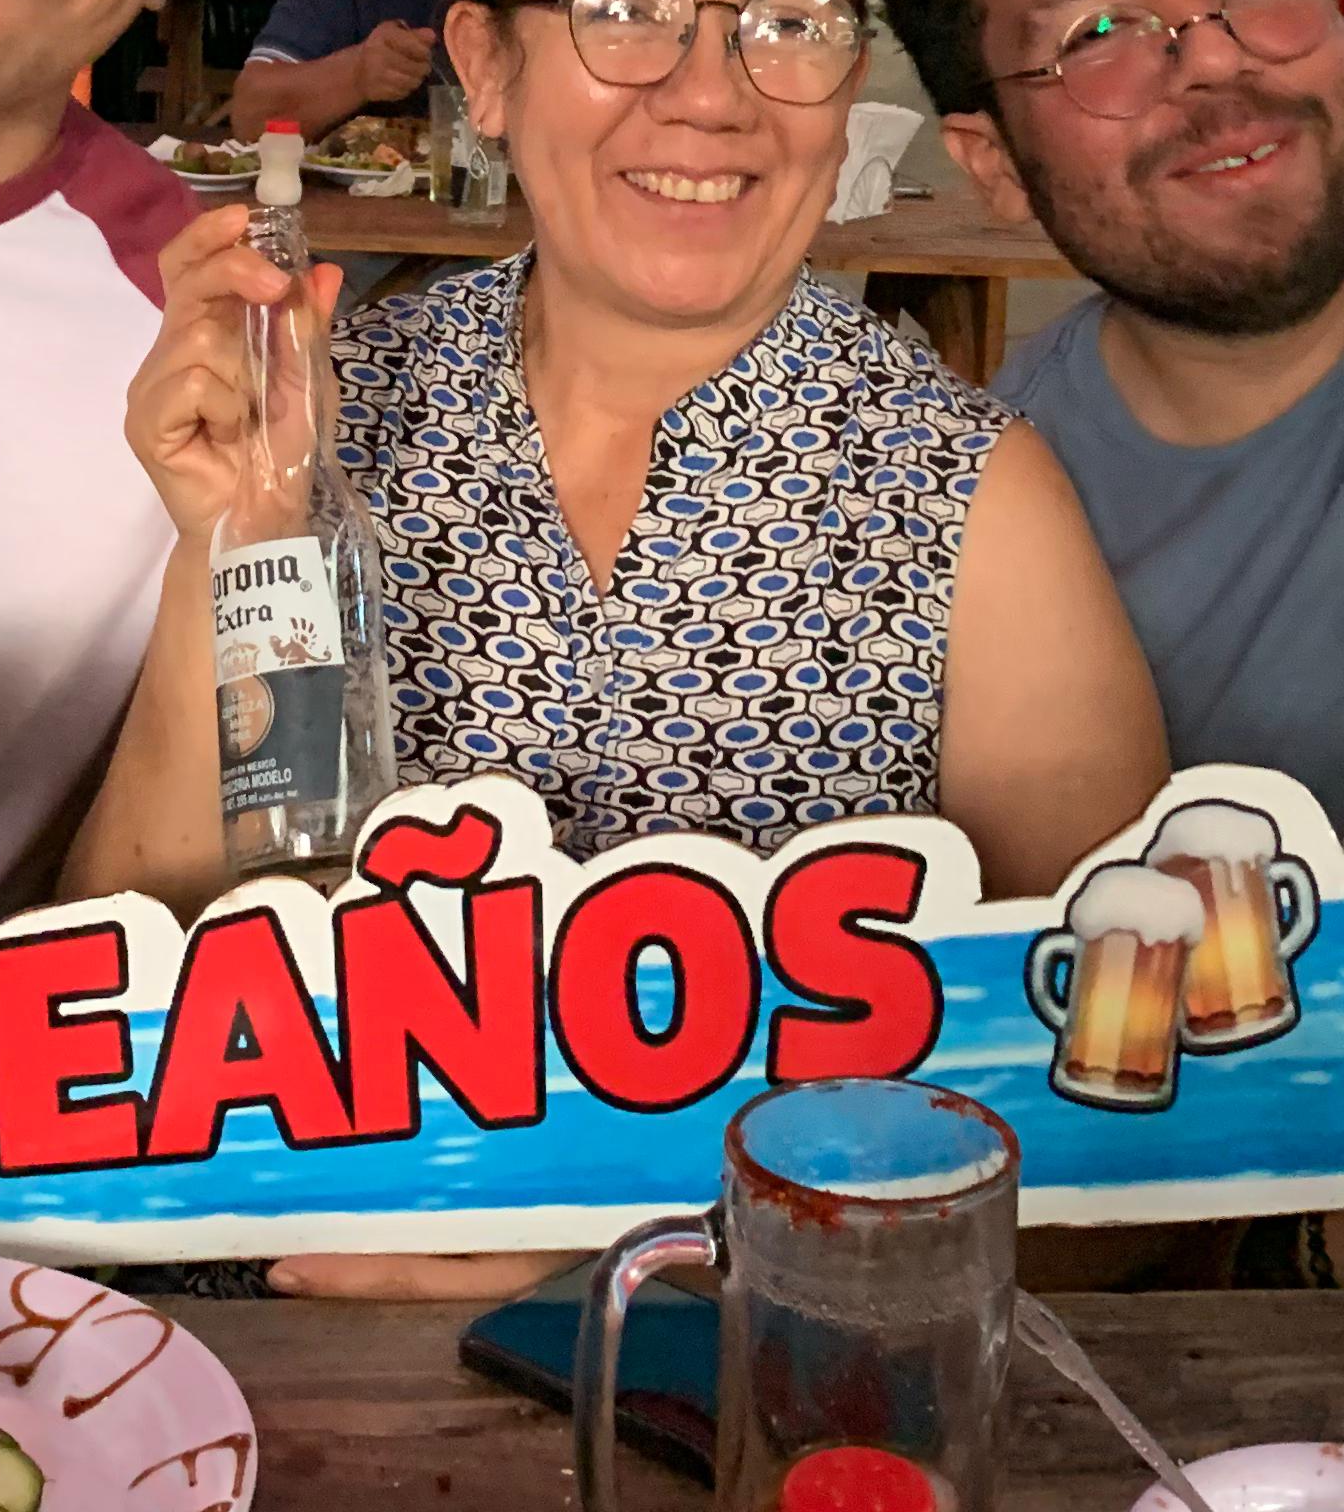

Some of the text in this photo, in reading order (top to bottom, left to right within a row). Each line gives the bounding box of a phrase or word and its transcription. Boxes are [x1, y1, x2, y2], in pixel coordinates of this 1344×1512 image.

[211, 555, 302, 601] orona
[215, 604, 273, 636] Extra
[252, 767, 293, 789] MODELO
